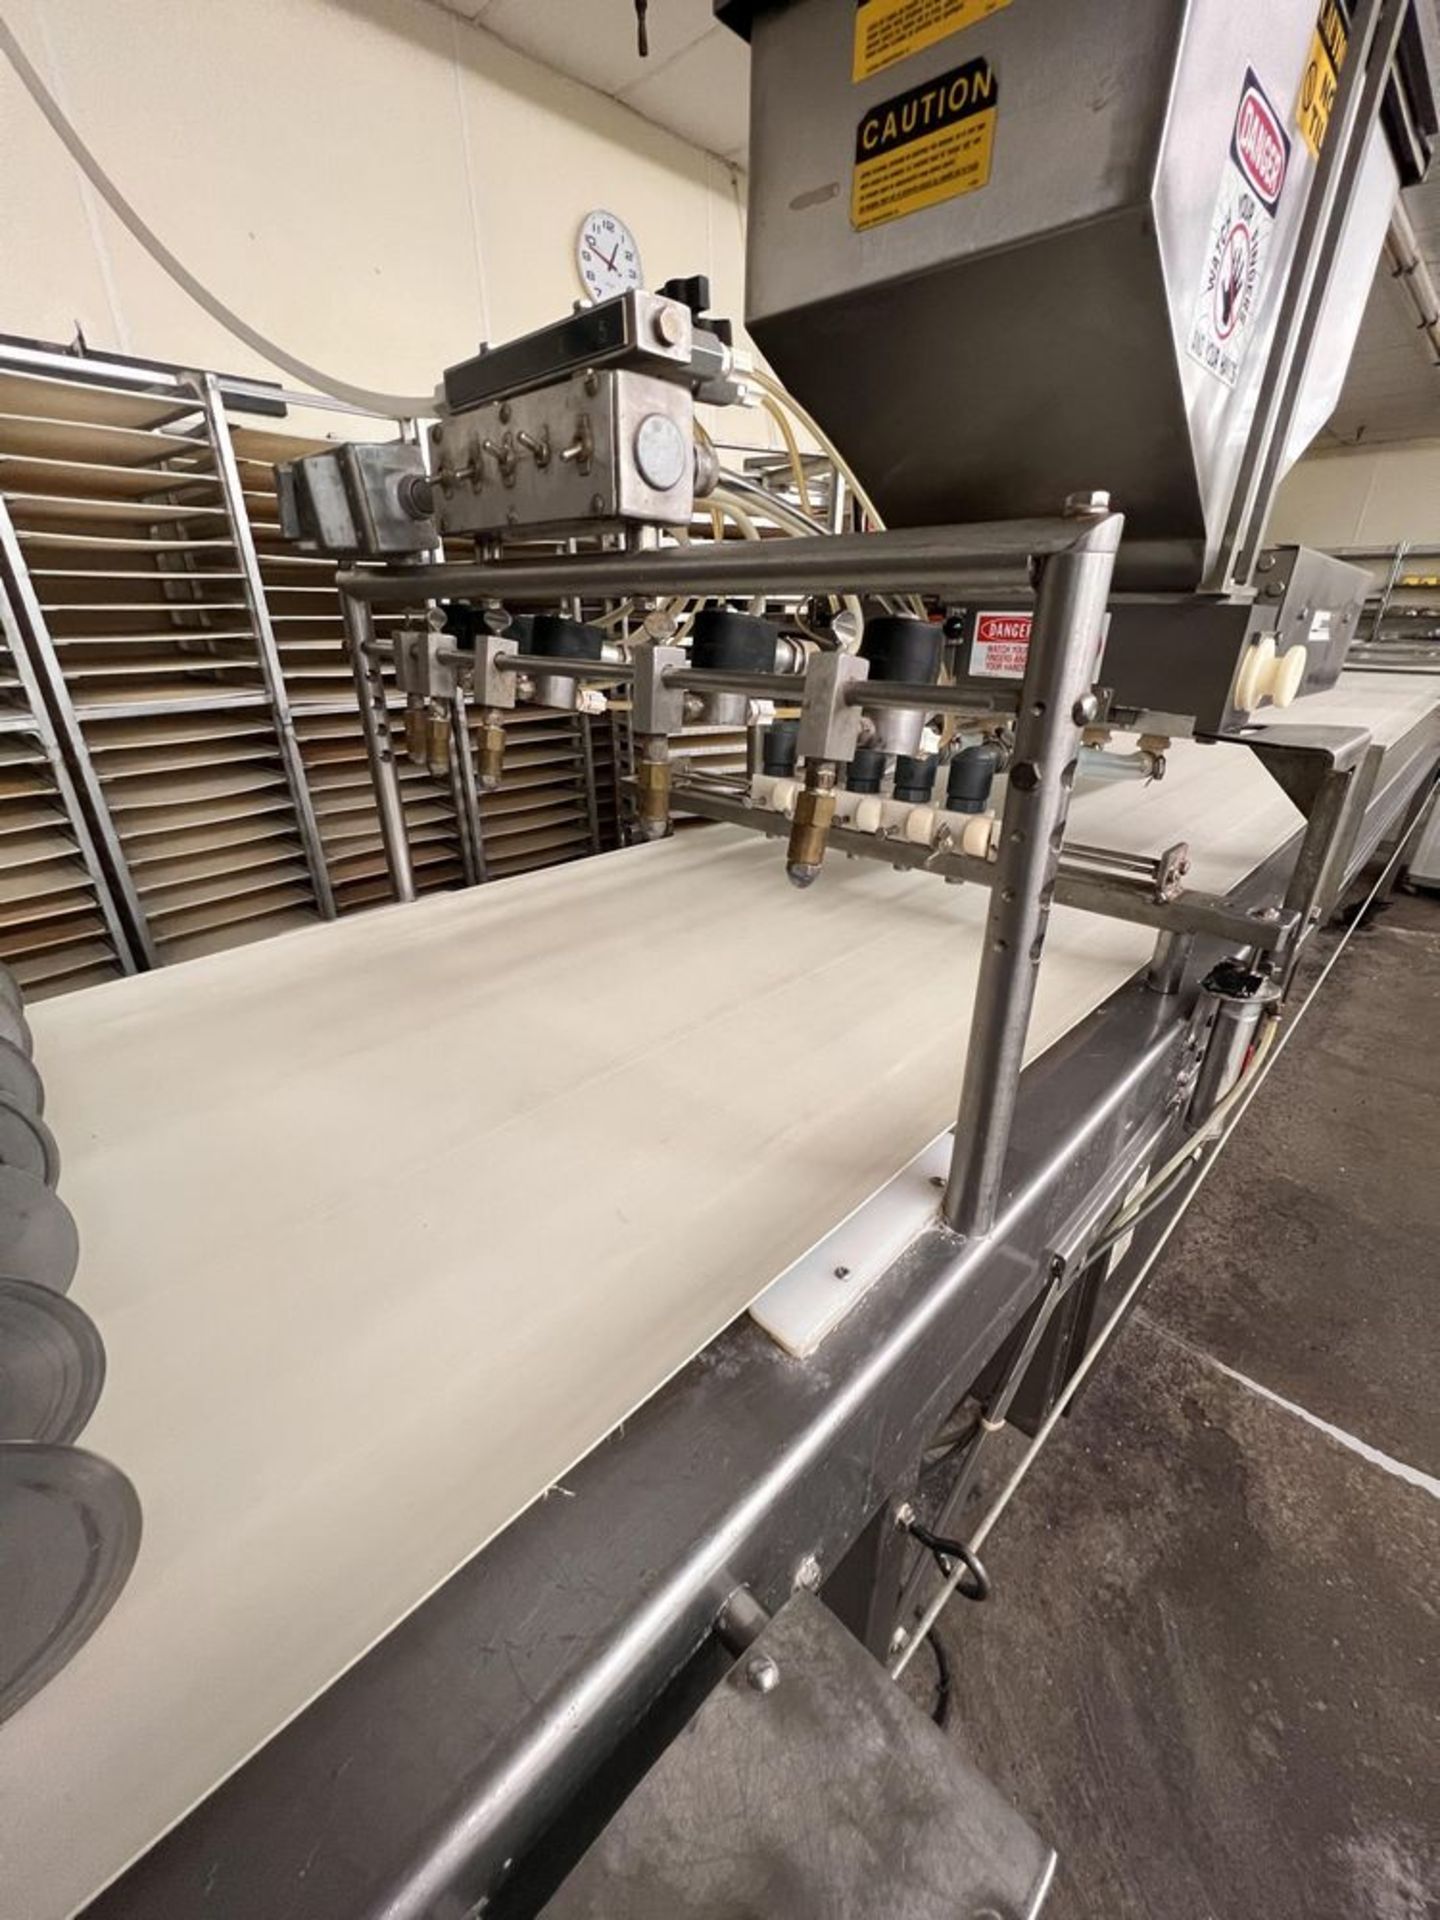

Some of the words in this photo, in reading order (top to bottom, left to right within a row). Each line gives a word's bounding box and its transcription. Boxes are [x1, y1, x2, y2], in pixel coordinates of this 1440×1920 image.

[863, 67, 992, 149] CAUTION
[1240, 99, 1281, 197] DANGER
[602, 219, 615, 233] 12
